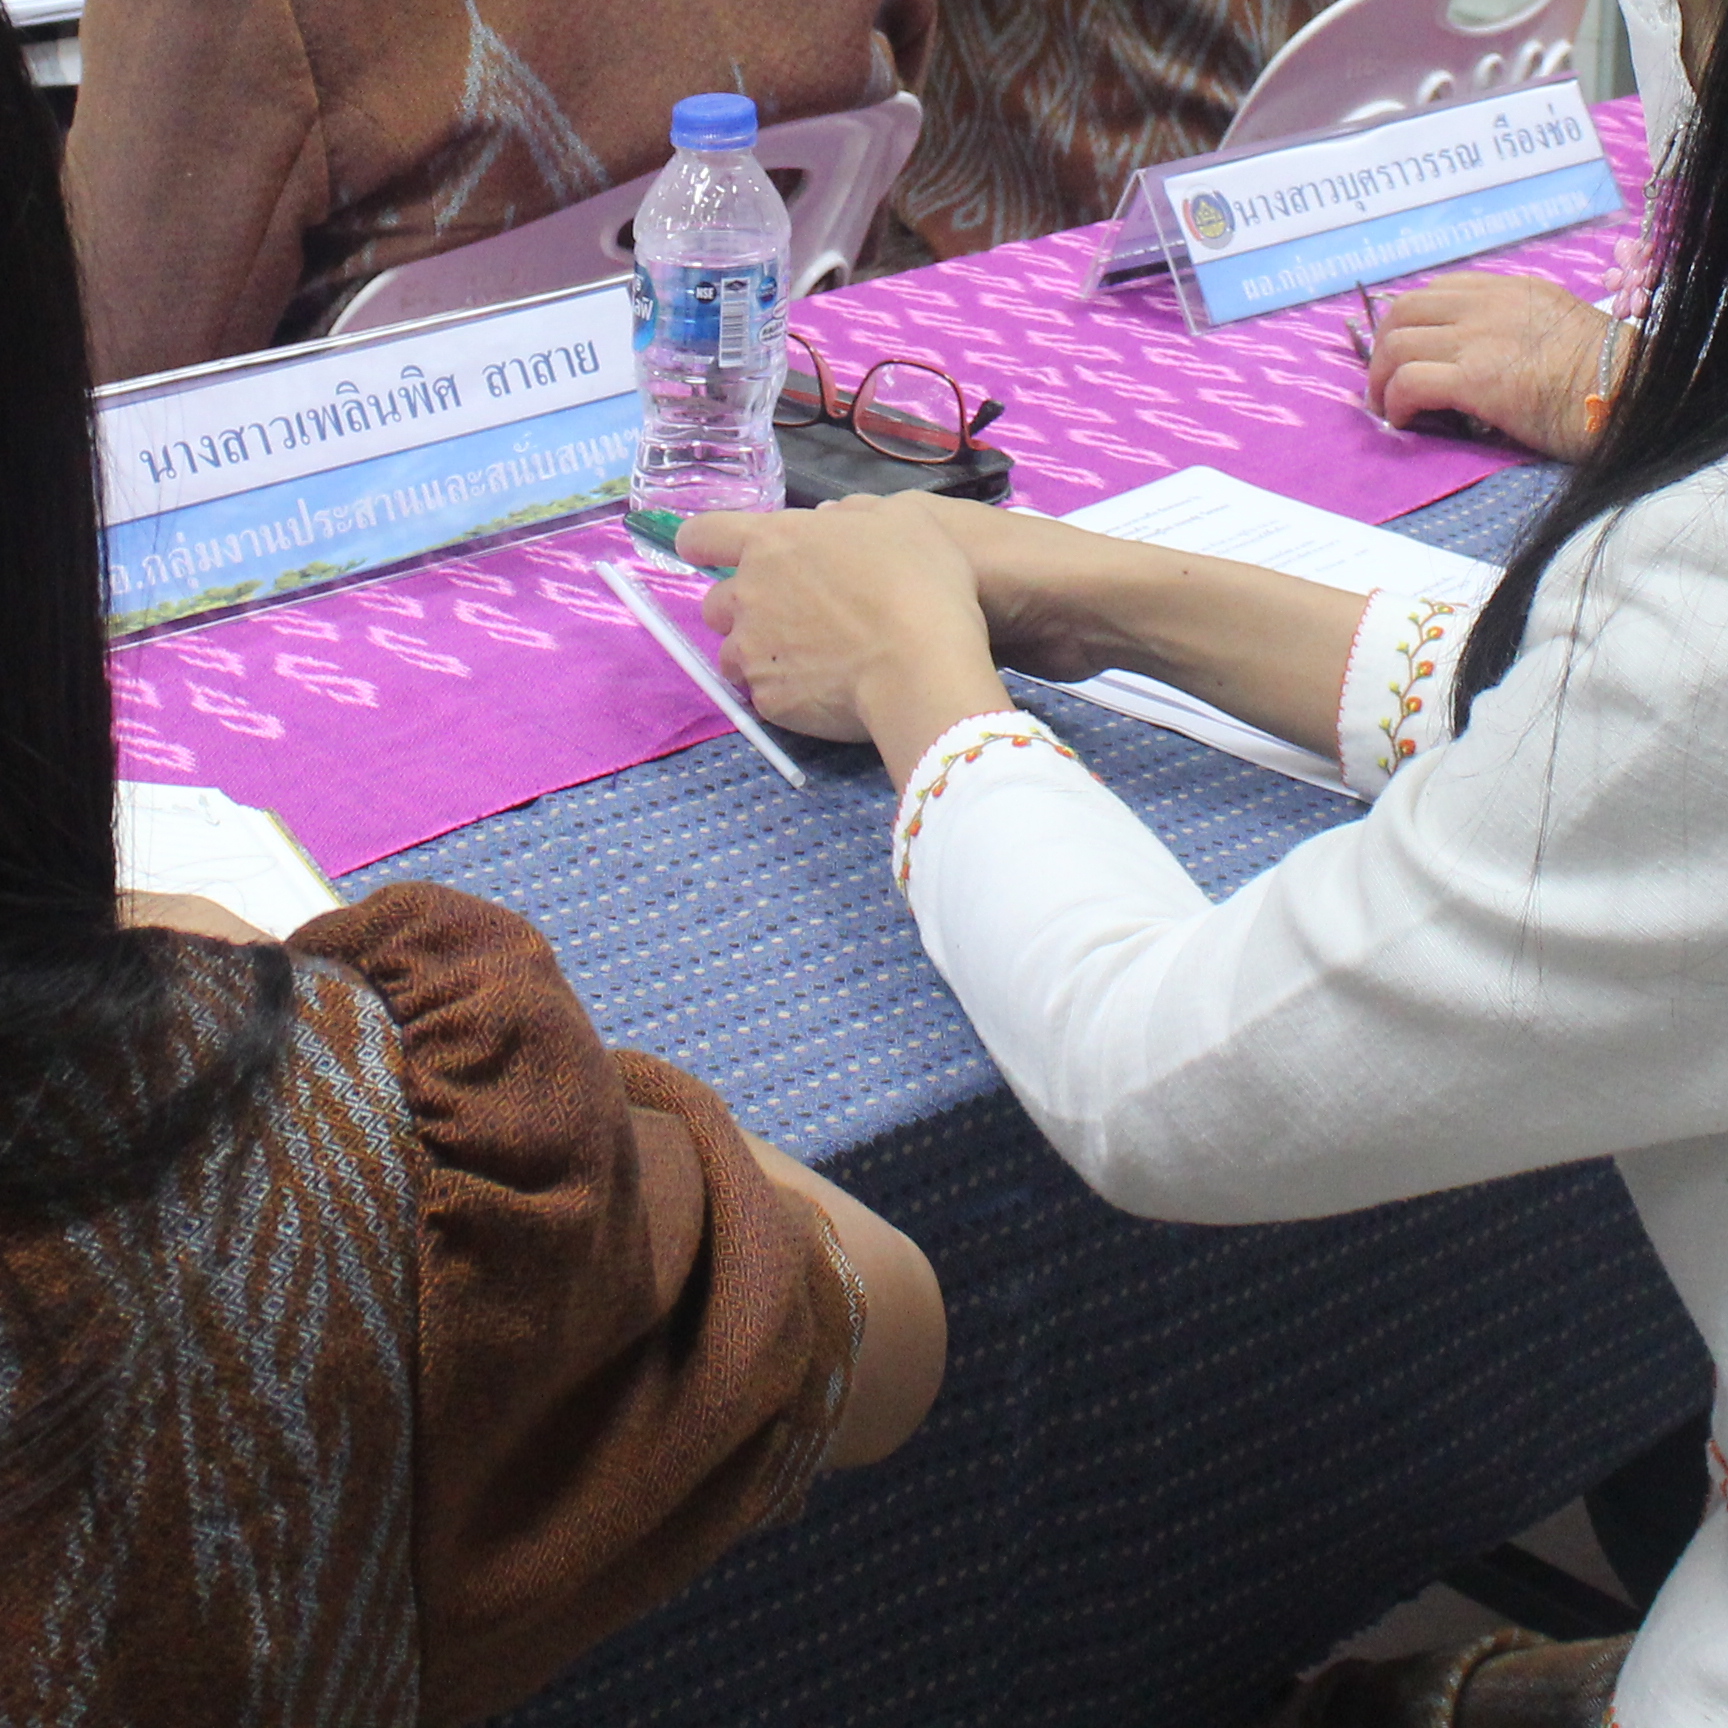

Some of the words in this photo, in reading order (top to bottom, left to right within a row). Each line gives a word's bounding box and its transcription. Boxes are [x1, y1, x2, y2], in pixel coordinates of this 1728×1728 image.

[1233, 137, 1481, 226] นางสาวบุศราวรรณ
[1493, 104, 1583, 161] เรืองช่อ
[139, 365, 462, 483] นางสาวเพลินพิศ
[482, 340, 600, 398] สาสาย
[108, 426, 642, 596] อ.กลุ่มงานประสานและสนับสนุนฯ
